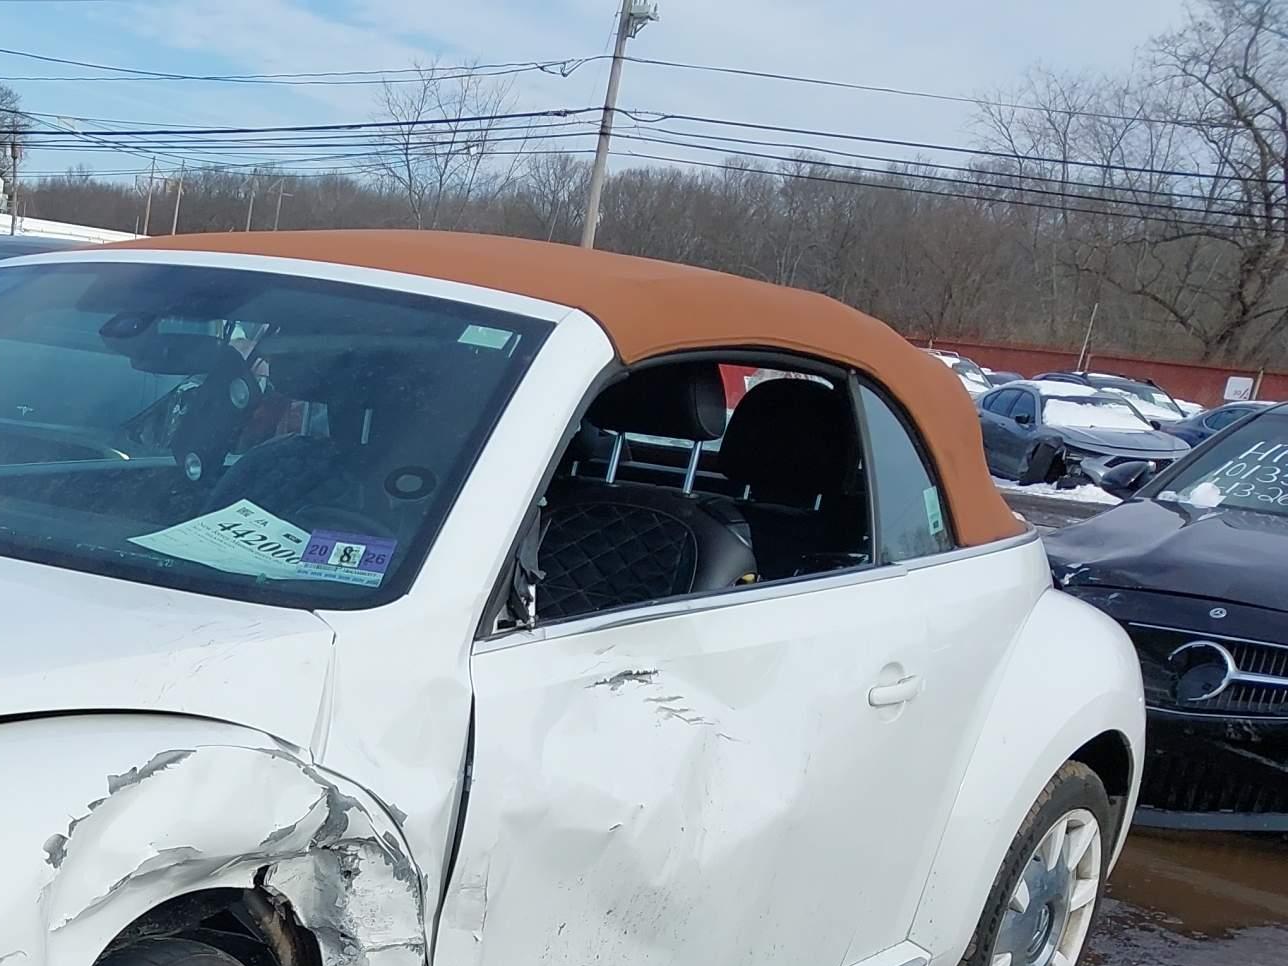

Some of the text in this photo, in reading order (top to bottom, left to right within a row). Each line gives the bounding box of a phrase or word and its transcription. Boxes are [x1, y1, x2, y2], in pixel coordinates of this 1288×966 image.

[308, 544, 386, 565] 20 8 26
